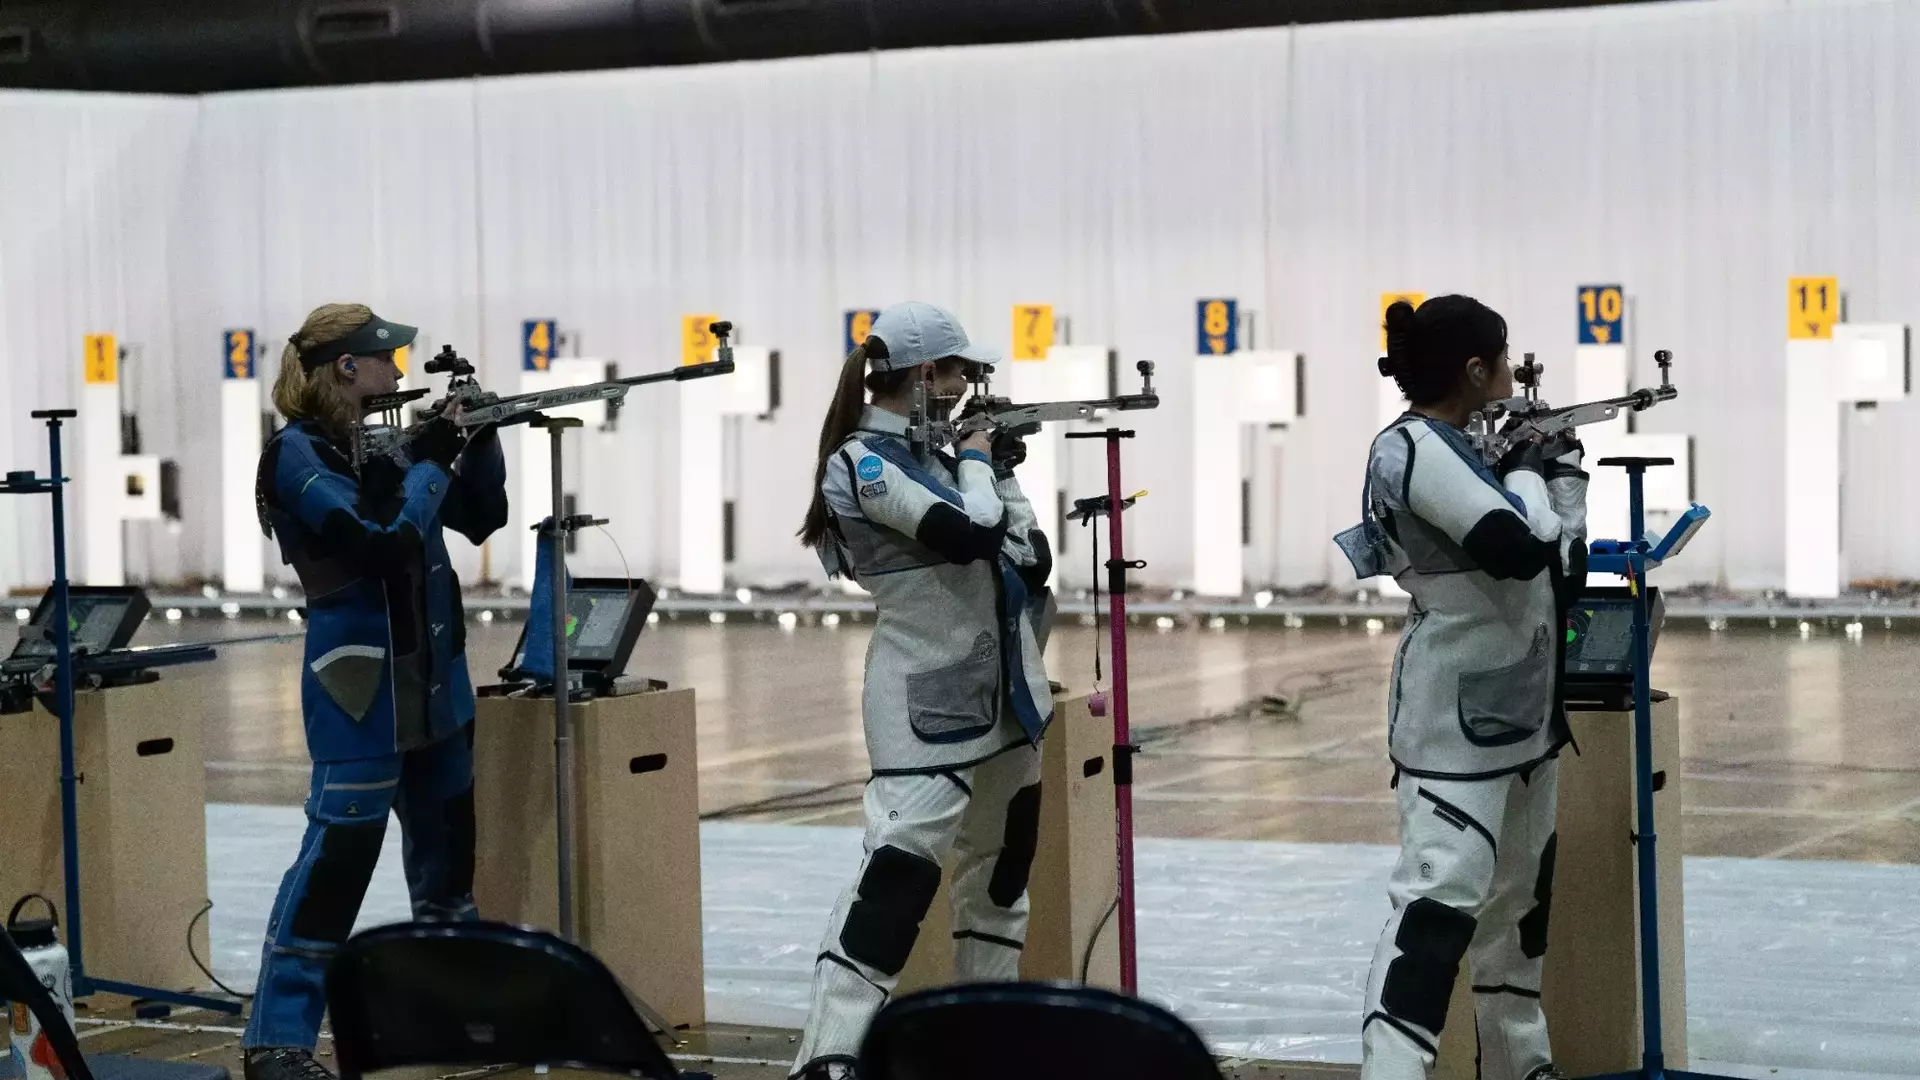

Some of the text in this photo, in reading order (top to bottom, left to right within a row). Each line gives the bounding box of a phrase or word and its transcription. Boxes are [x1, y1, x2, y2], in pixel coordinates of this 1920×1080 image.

[1579, 289, 1622, 322] 10
[1796, 284, 1828, 313] 11
[693, 318, 708, 347] 5
[852, 311, 872, 346] 6
[1022, 308, 1041, 338] 7
[1205, 301, 1228, 335] 8
[93, 337, 105, 363] 1
[231, 331, 249, 362] 2
[530, 321, 549, 352] 4
